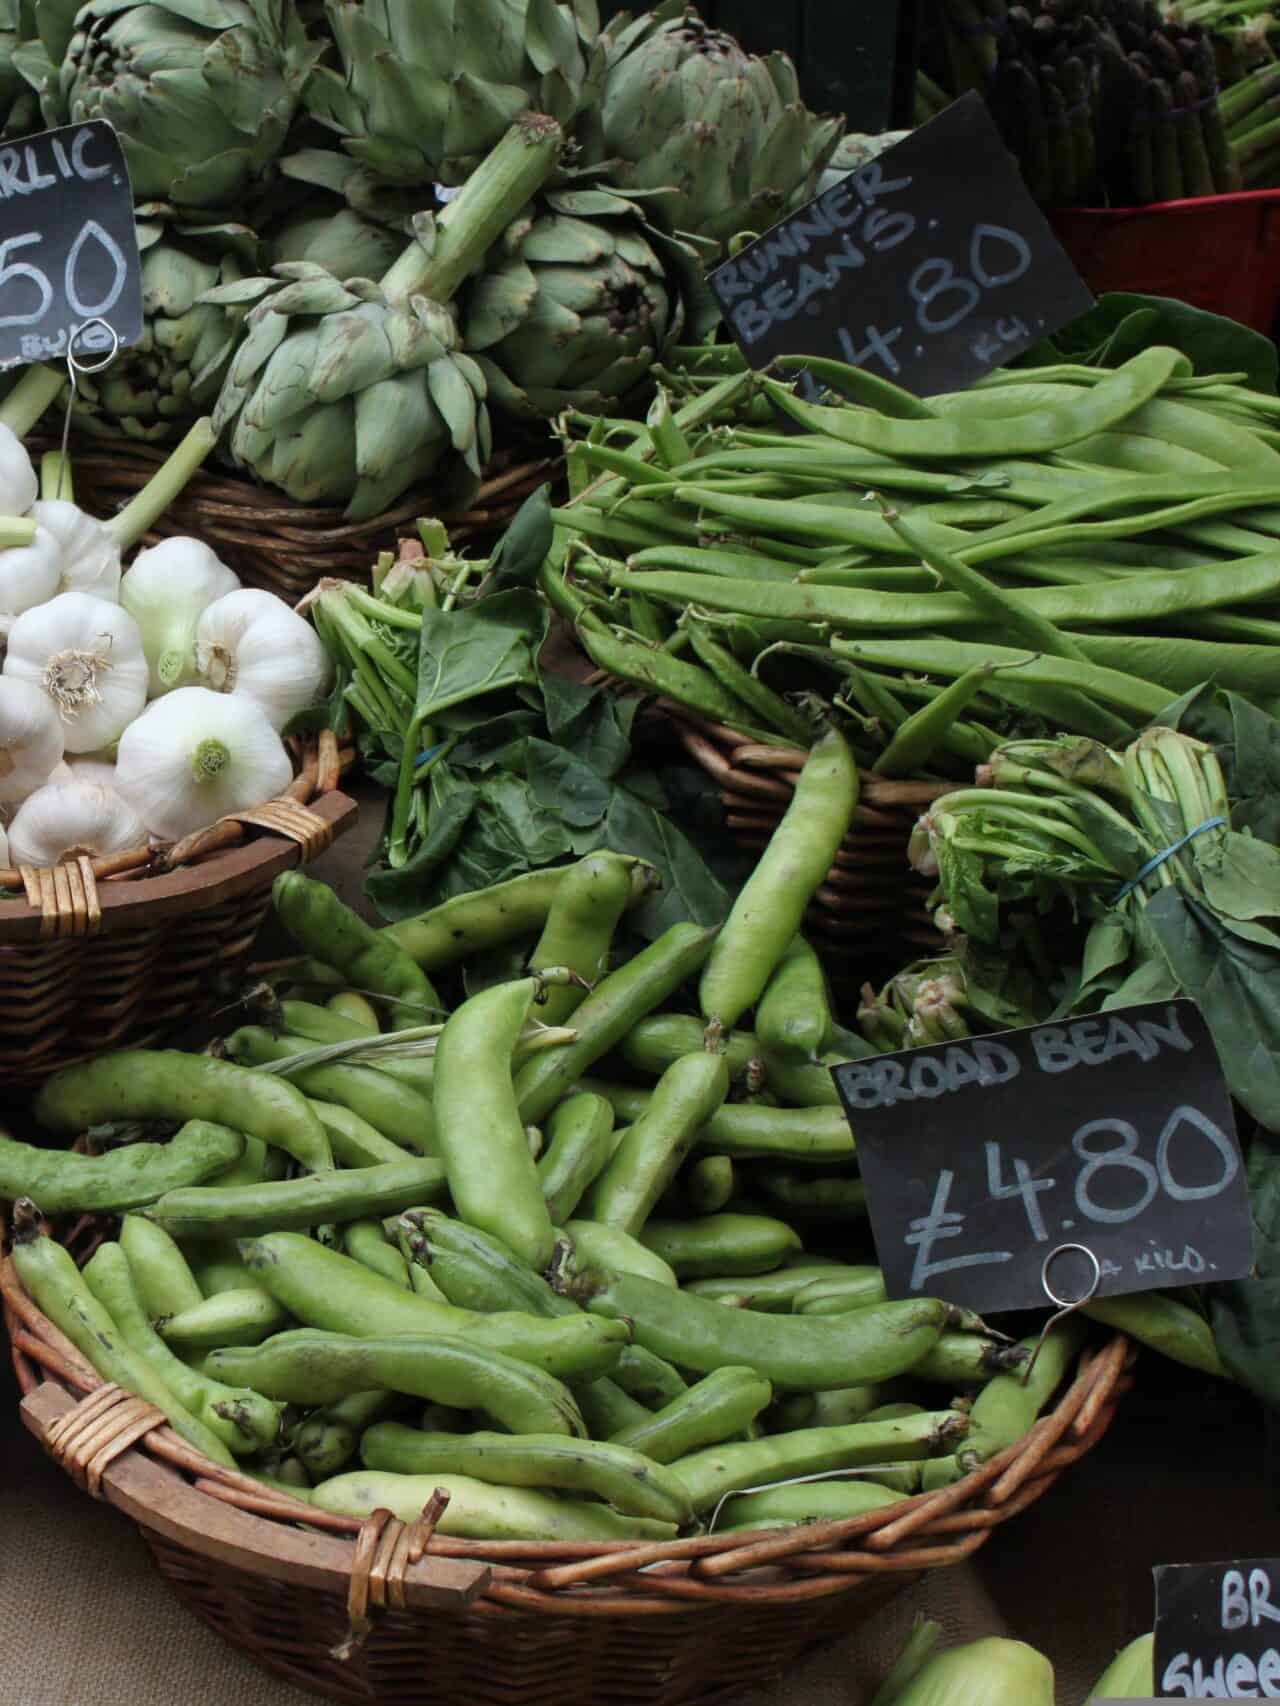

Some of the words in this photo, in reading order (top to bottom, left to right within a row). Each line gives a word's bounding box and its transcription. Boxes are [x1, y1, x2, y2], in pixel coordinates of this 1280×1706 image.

[714, 161, 913, 299] RUNNER
[836, 1039, 1020, 1109] BROAD
[1030, 1006, 1195, 1074] BEAN
[904, 1105, 1240, 1290] £4.80
